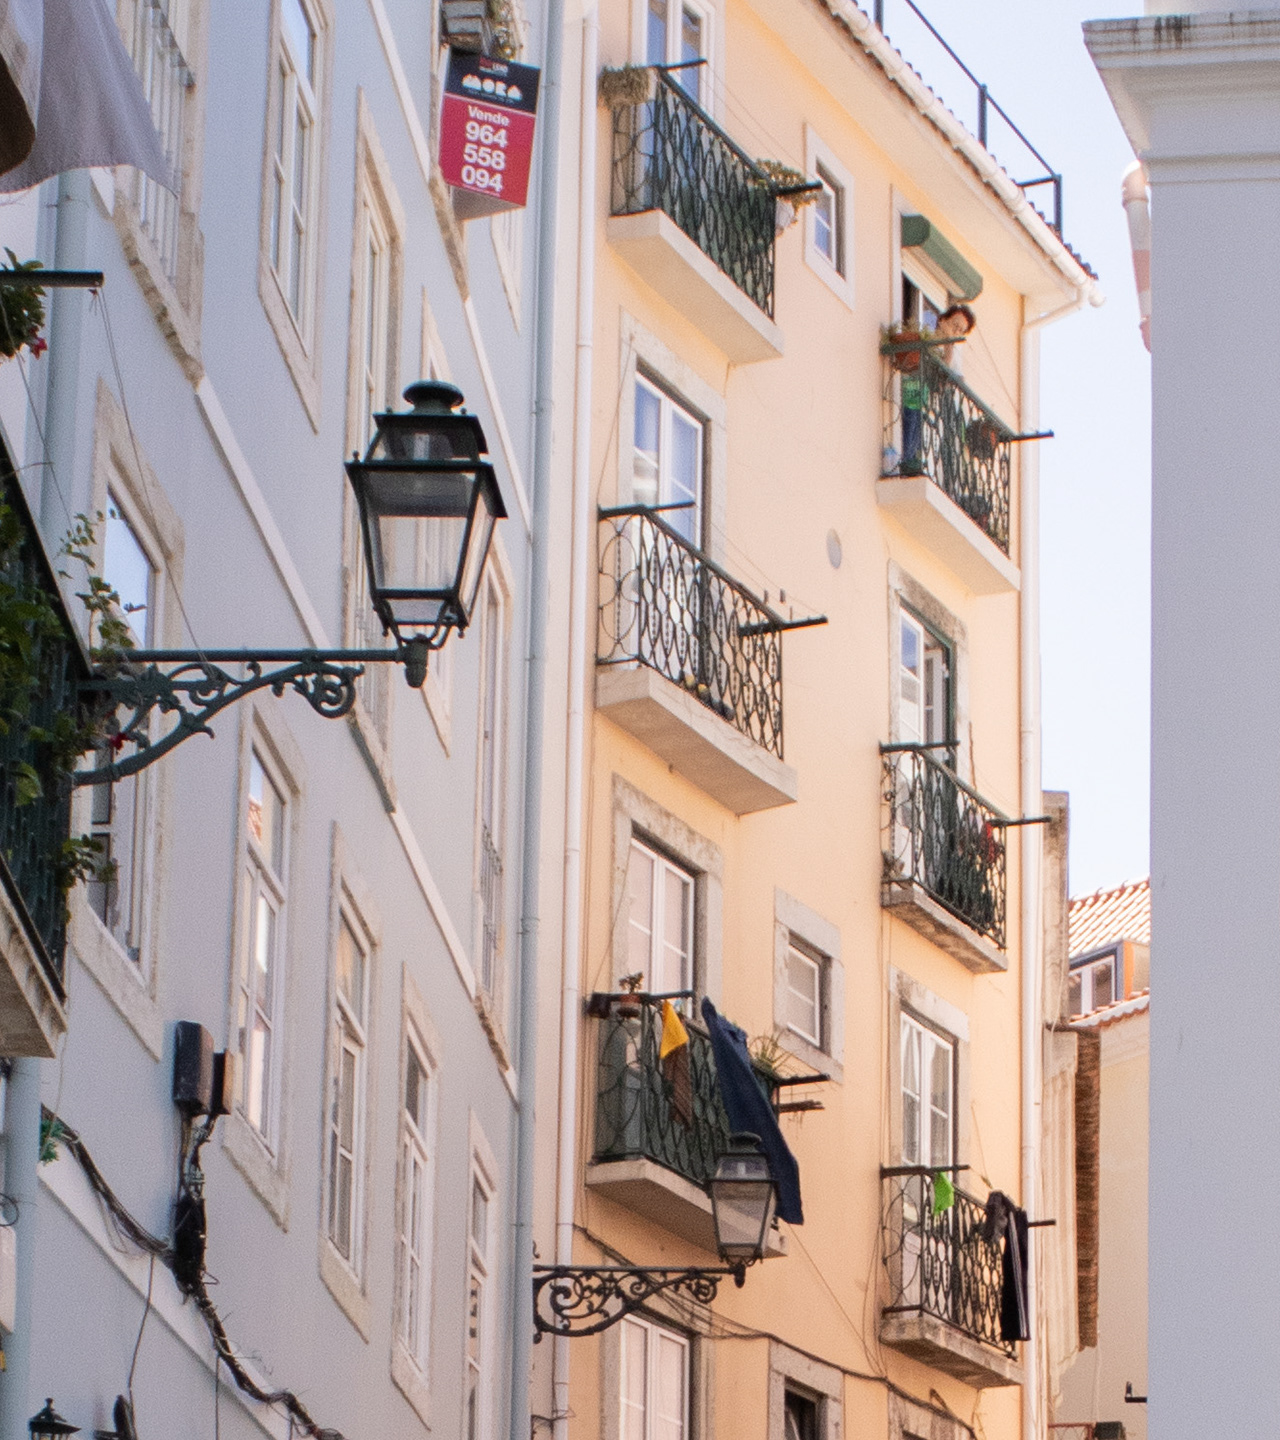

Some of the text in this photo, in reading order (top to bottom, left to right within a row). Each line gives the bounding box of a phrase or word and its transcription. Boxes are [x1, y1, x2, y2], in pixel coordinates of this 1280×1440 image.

[468, 105, 510, 126] Vende
[465, 121, 508, 148] 964
[463, 142, 506, 171] 558
[461, 165, 504, 192] 094
